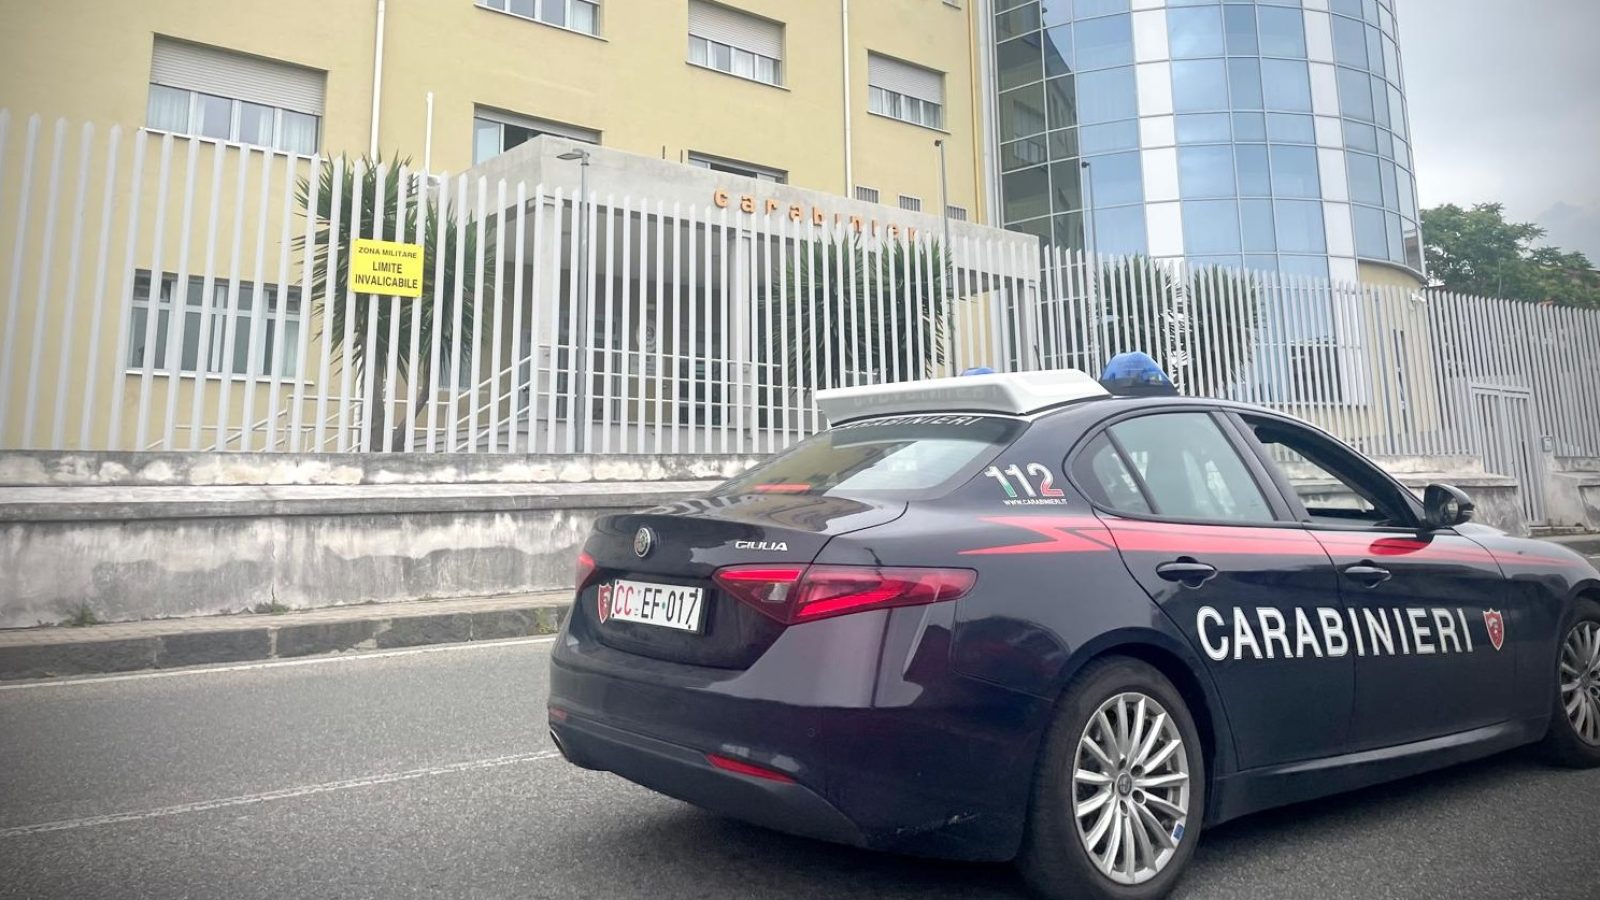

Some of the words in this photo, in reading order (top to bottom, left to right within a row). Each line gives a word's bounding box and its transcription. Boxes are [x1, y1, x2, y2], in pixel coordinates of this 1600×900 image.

[358, 247, 380, 255] ZONA
[382, 249, 417, 258] MILITARE
[372, 262, 402, 274] LIMITE
[355, 274, 418, 288] INVALICABILE
[984, 462, 1065, 497] 112
[735, 540, 788, 551] GIULIA
[615, 584, 634, 616] CC
[666, 590, 698, 625] 017
[1196, 605, 1474, 661] CARABINIERI
